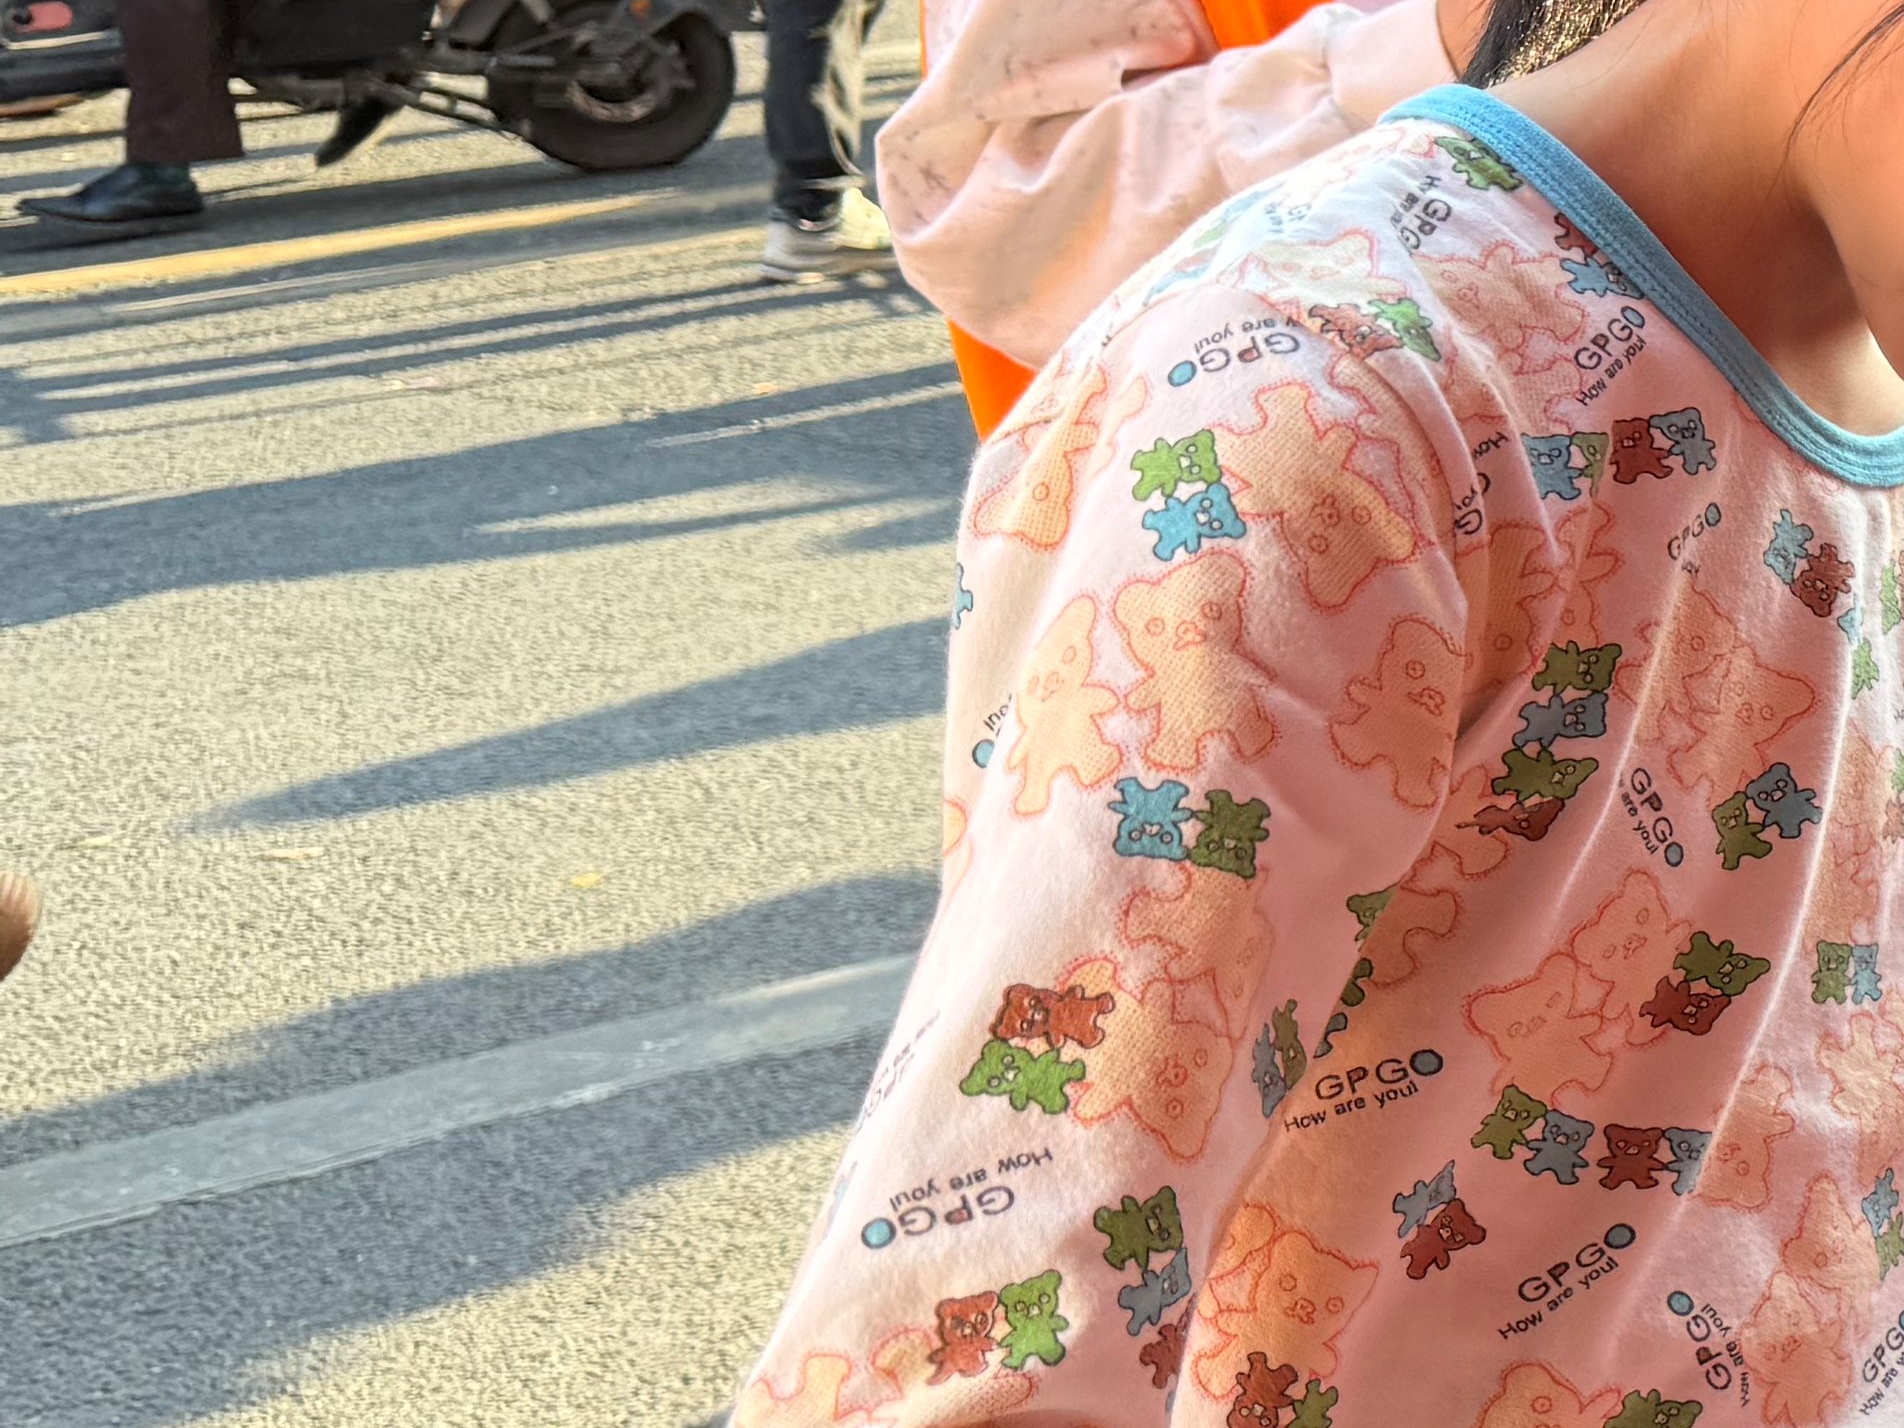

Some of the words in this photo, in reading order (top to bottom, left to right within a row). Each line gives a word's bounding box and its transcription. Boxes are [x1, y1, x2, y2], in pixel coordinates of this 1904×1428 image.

[1167, 333, 1301, 388] GPGO
[1573, 305, 1646, 371] GPGO
[1576, 378, 1609, 408] How
[1606, 356, 1626, 381] are
[1629, 768, 1684, 868] GPGO
[1314, 1048, 1444, 1102] GPGO
[1284, 1111, 1329, 1133] How
[1334, 1096, 1366, 1115] are
[950, 1168, 988, 1190] are
[998, 1147, 1053, 1175] How
[861, 1185, 1015, 1249] GPGO
[1517, 1223, 1636, 1304] GPGO
[1498, 1311, 1544, 1340] How
[1545, 1286, 1575, 1312] are
[1666, 1290, 1732, 1391] GPGO
[1859, 1385, 1886, 1416] How
[1879, 1365, 1901, 1389] are
